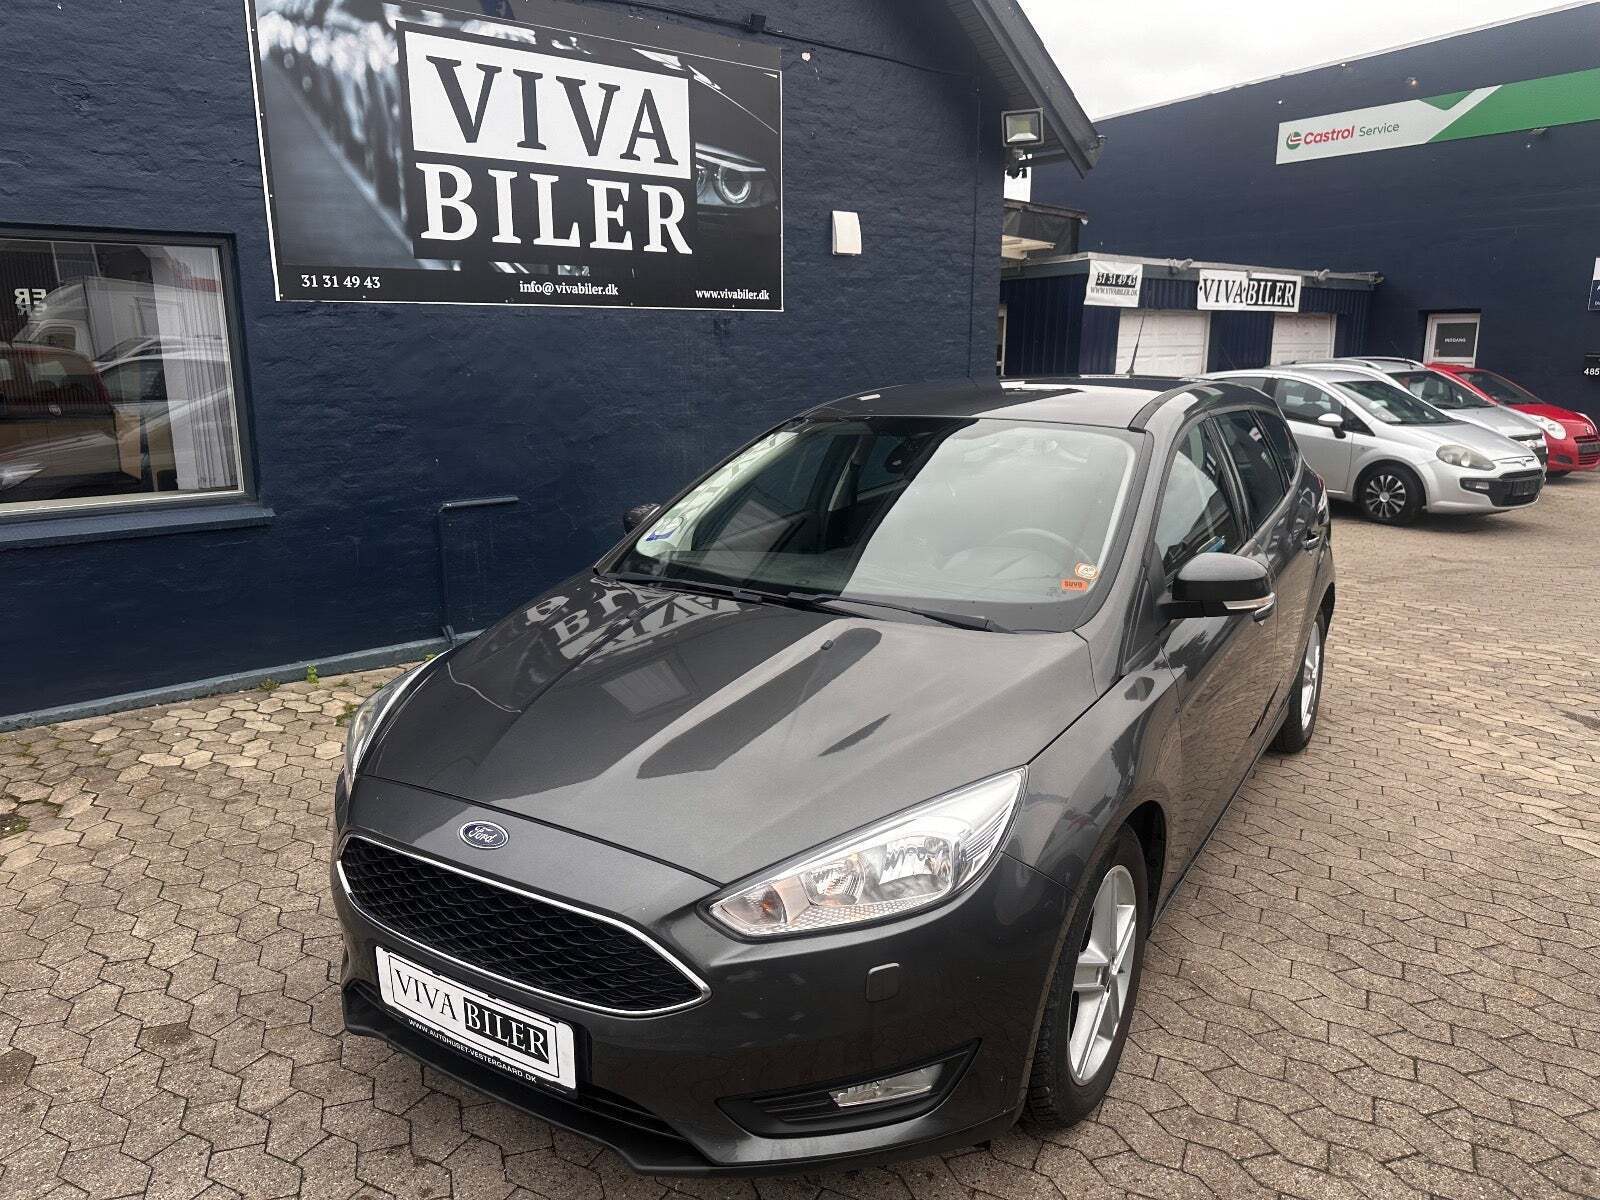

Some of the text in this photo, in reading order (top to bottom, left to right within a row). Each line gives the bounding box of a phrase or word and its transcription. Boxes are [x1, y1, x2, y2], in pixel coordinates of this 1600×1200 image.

[426, 55, 680, 166] VIVA
[1303, 122, 1400, 145] Castrol Service
[415, 162, 693, 255] BILER
[301, 274, 381, 289] 31 31 49 43
[519, 280, 619, 296] info@vivabiler.dk
[1202, 278, 1295, 307] VIVA BILER
[695, 288, 770, 300] www.vivabiler.dk
[468, 825, 498, 844] Ford
[395, 969, 549, 1059] VIVA BILER
